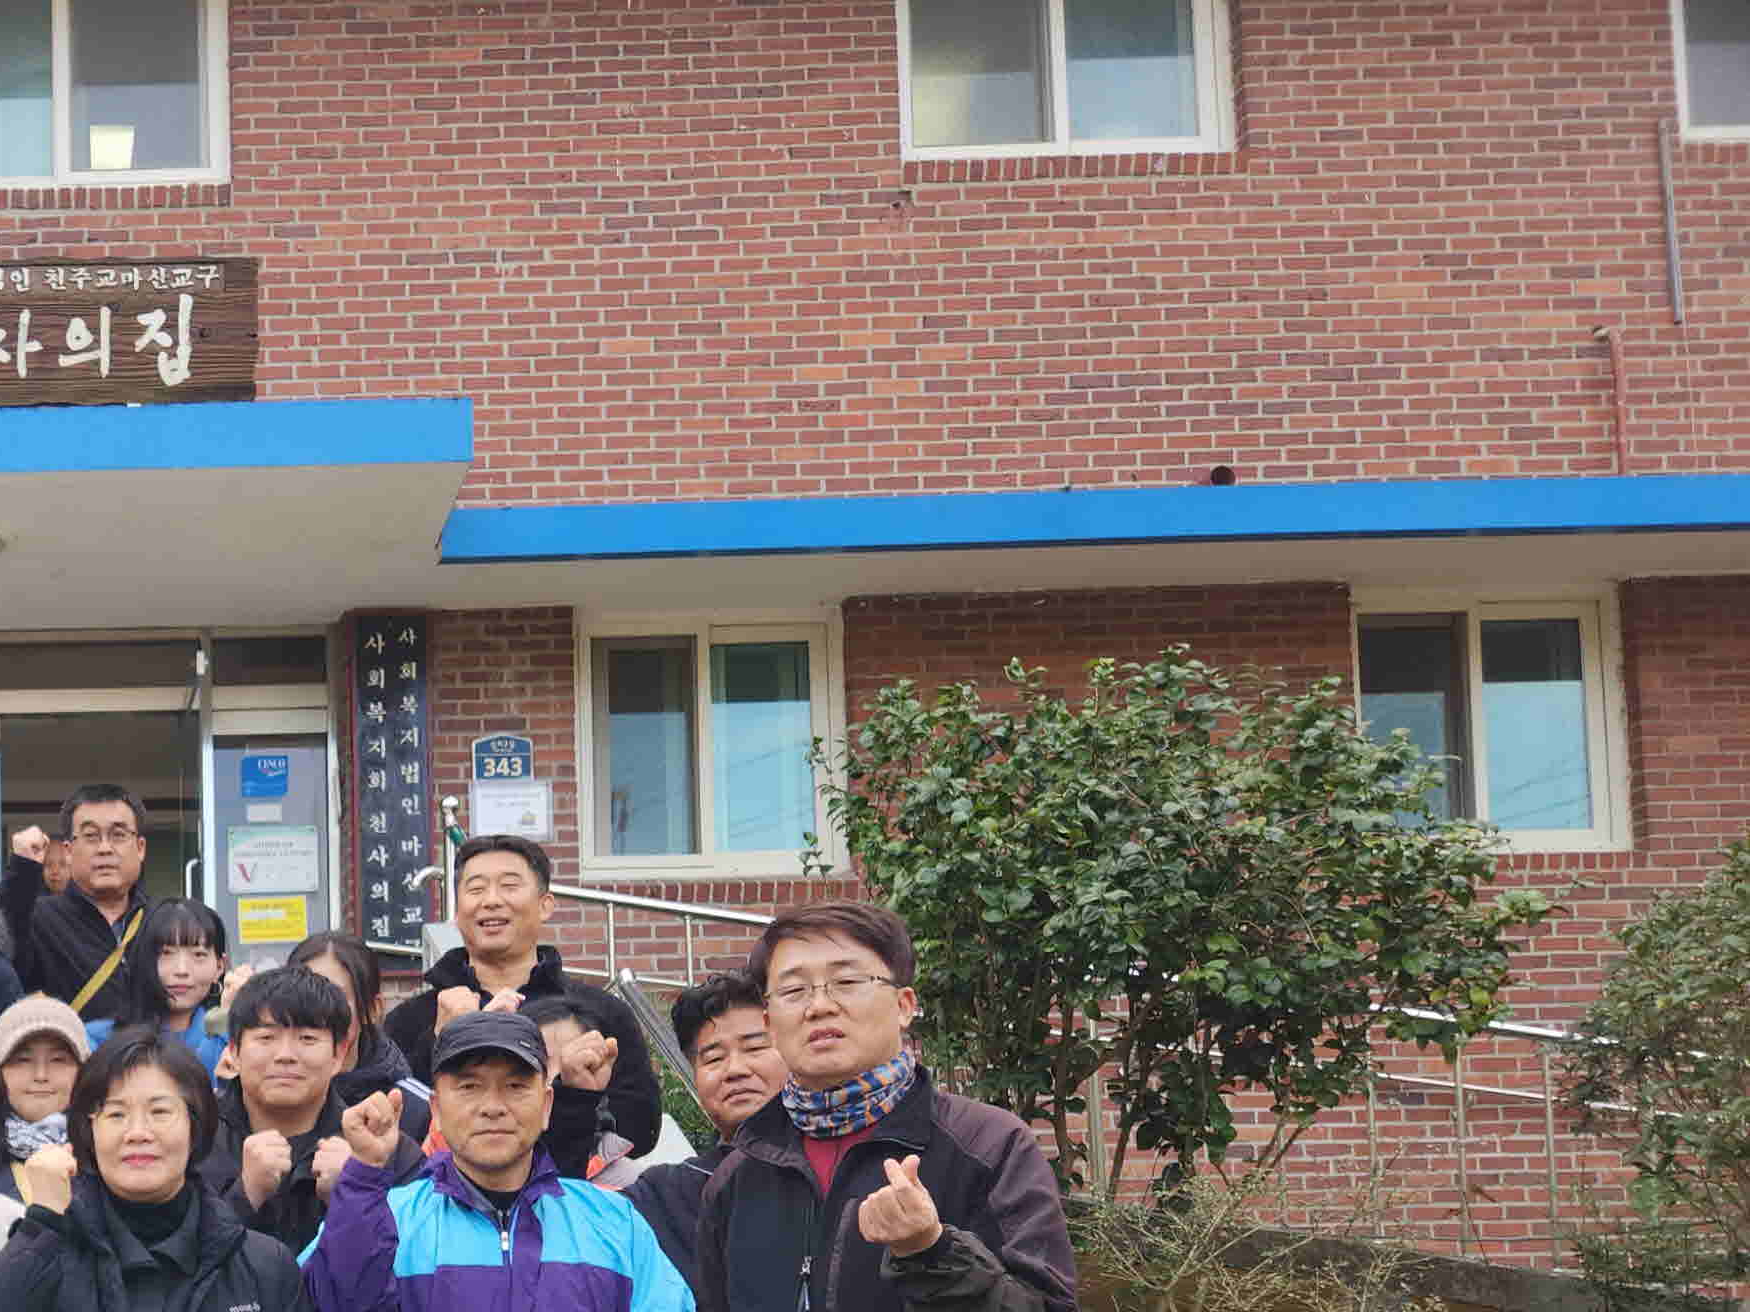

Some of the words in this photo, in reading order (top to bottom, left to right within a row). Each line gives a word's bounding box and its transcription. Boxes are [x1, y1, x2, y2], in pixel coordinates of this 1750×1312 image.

[365, 632, 387, 791] 사회복지회
[399, 628, 422, 816] 사회복지법인
[483, 757, 523, 777] 343
